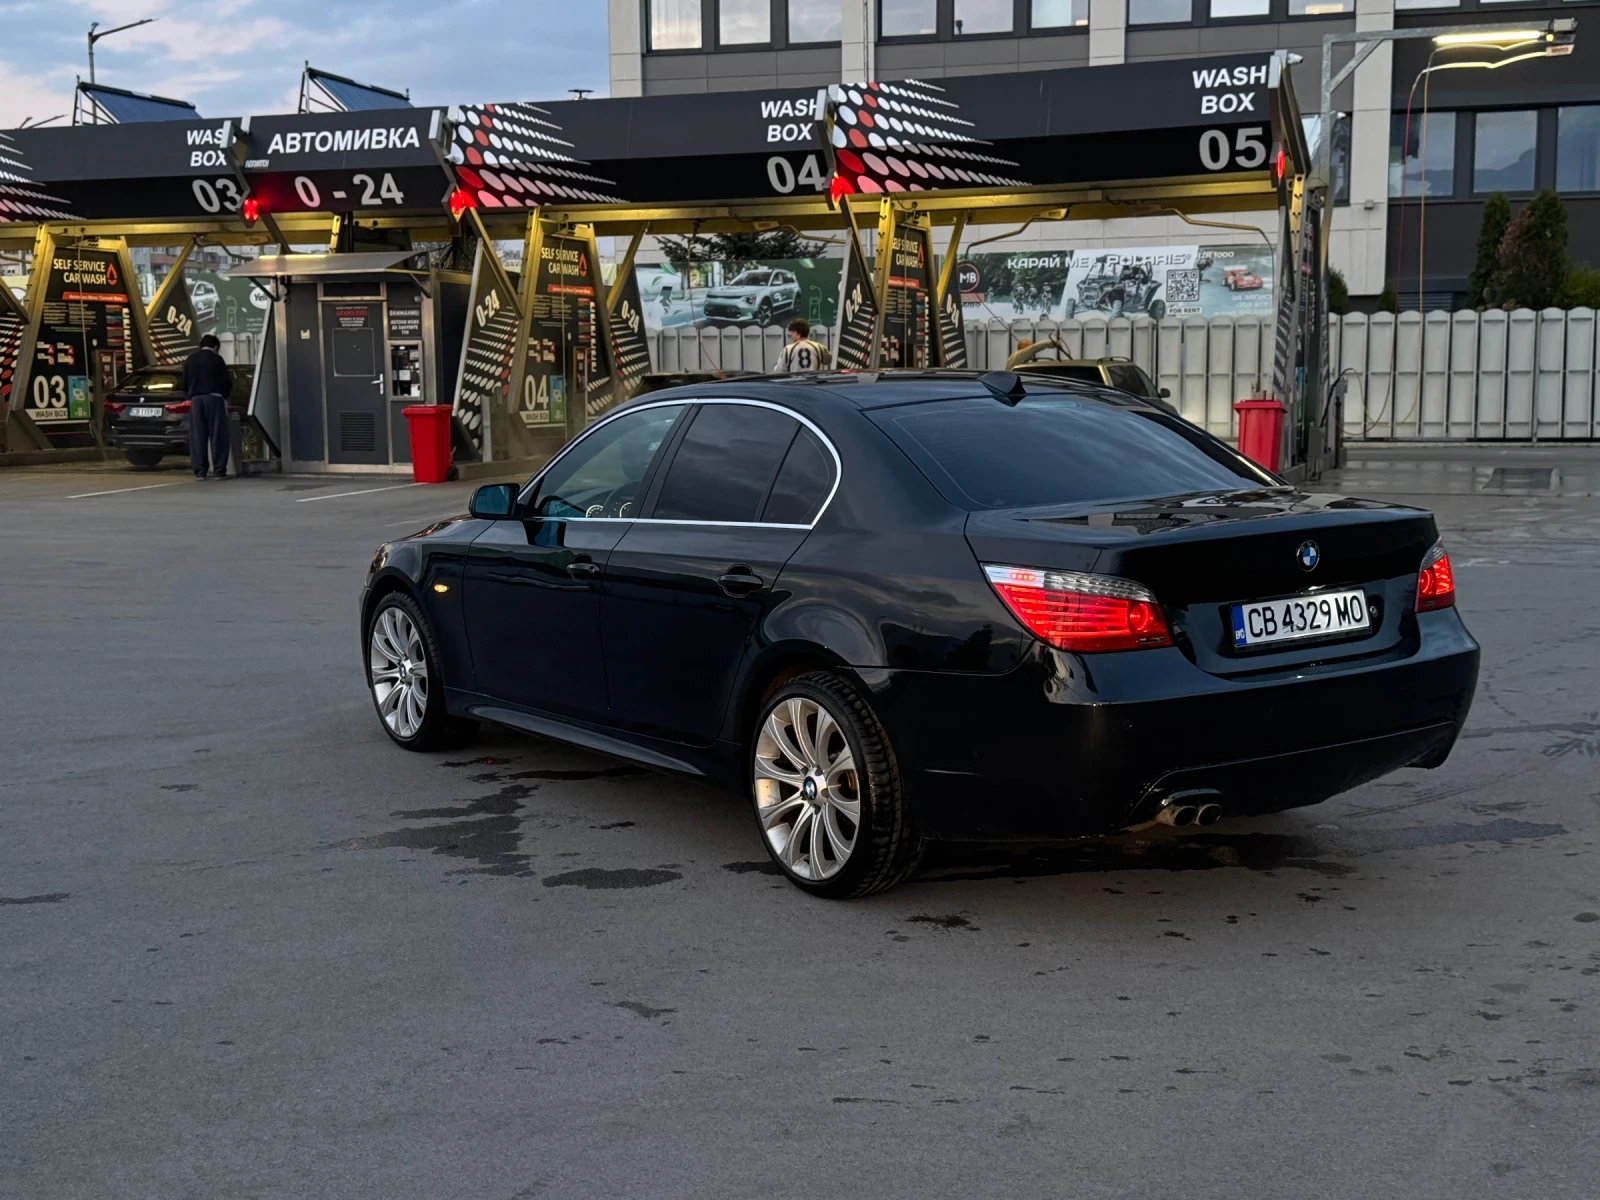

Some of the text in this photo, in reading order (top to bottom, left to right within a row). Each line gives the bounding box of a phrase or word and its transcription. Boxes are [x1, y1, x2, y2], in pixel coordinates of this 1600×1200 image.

[1192, 64, 1267, 89] WASH
[1201, 91, 1256, 115] BOX
[186, 128, 237, 146] WAS
[267, 126, 420, 155] АВТОМИВКА
[767, 122, 813, 142] BOX
[190, 149, 227, 167] BOX
[1198, 126, 1267, 171] 05
[766, 154, 826, 194] 04
[191, 178, 243, 213] 03
[294, 176, 321, 208] 0
[352, 172, 404, 206] 24
[53, 258, 106, 273] SELF SERVICE
[541, 247, 555, 259] SELF
[548, 261, 562, 274] CAR
[1007, 254, 1061, 270] КАРАЙ
[63, 271, 107, 285] CAR WASH
[476, 287, 501, 328] 0-24
[845, 282, 863, 322] 0-24
[946, 293, 960, 329] 0-24
[166, 305, 192, 337] 0-24
[621, 300, 640, 334] 0-24
[798, 348, 812, 369] 8
[33, 375, 67, 409] 03
[524, 374, 549, 411] 04
[35, 410, 54, 418] WASH
[1248, 594, 1363, 638] CB 4329 MO
